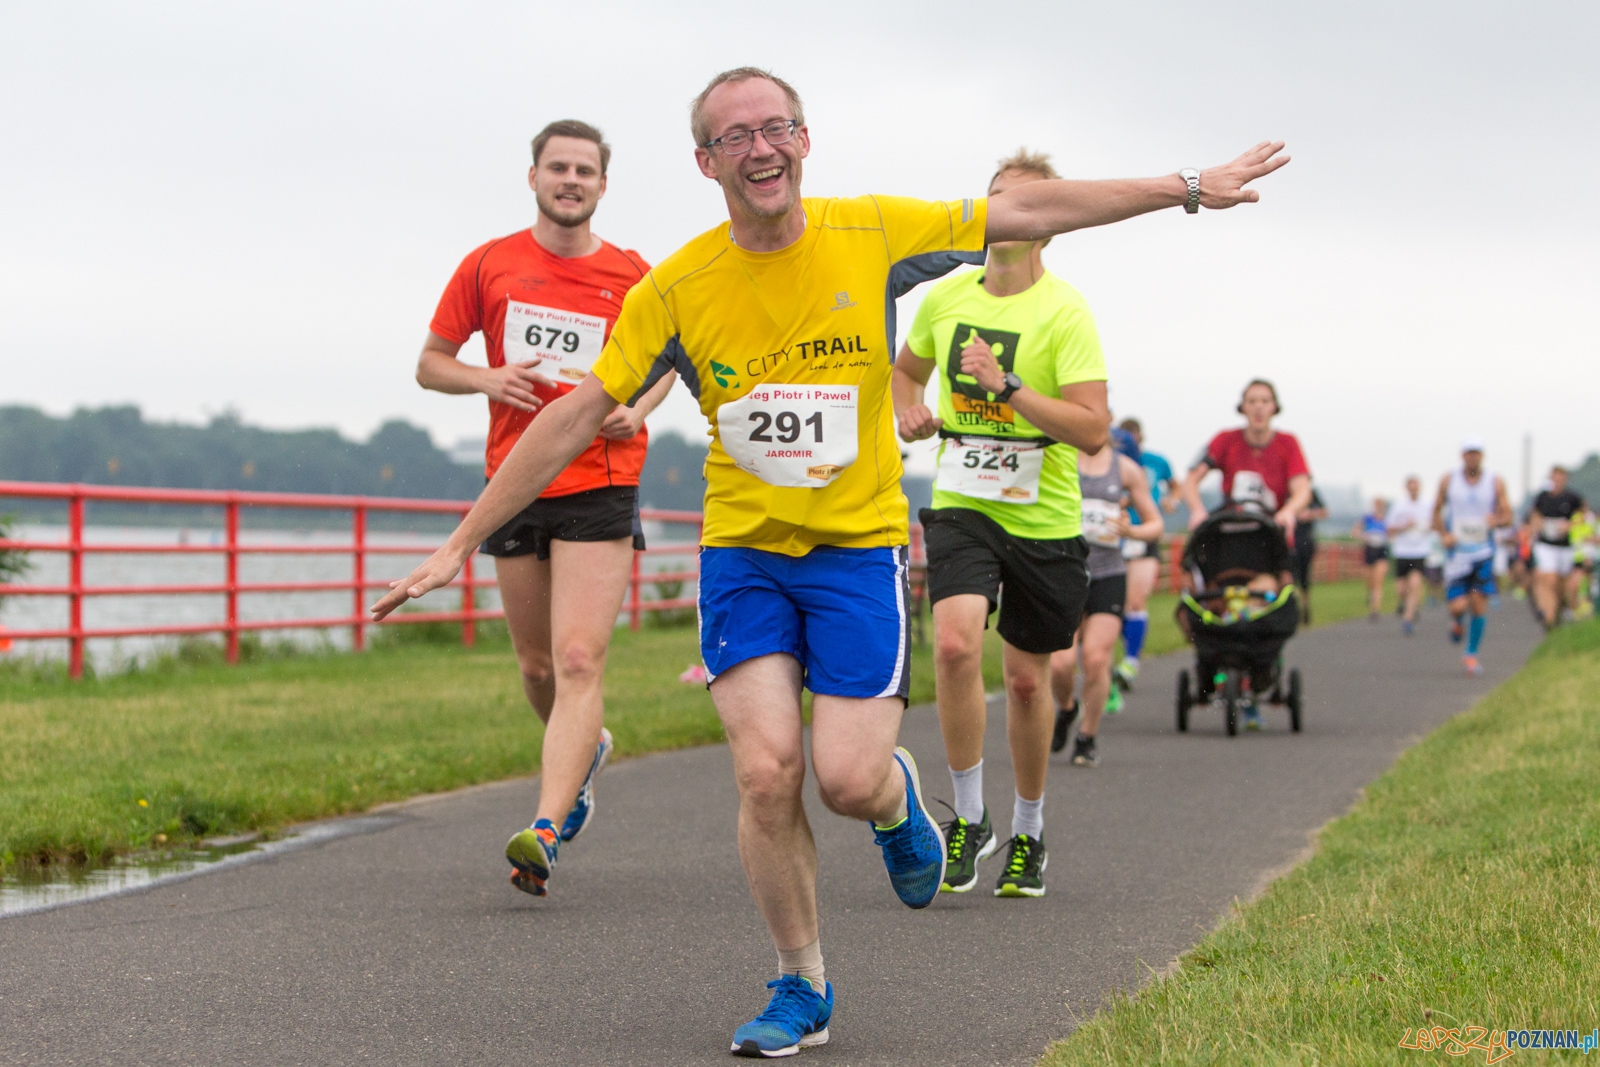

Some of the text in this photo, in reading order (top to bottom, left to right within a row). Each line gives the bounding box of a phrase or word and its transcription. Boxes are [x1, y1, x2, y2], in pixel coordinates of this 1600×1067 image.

[525, 308, 544, 319] Bieg
[546, 312, 567, 322] Piotr
[524, 323, 580, 353] 679
[535, 351, 563, 361] MACIEJ
[747, 345, 794, 378] CITY
[773, 390, 804, 400] Piotr
[807, 390, 811, 400] i
[814, 390, 851, 401] Paweł
[747, 410, 824, 444] 291
[765, 450, 813, 458] JAROMIR
[962, 449, 1019, 472] 524
